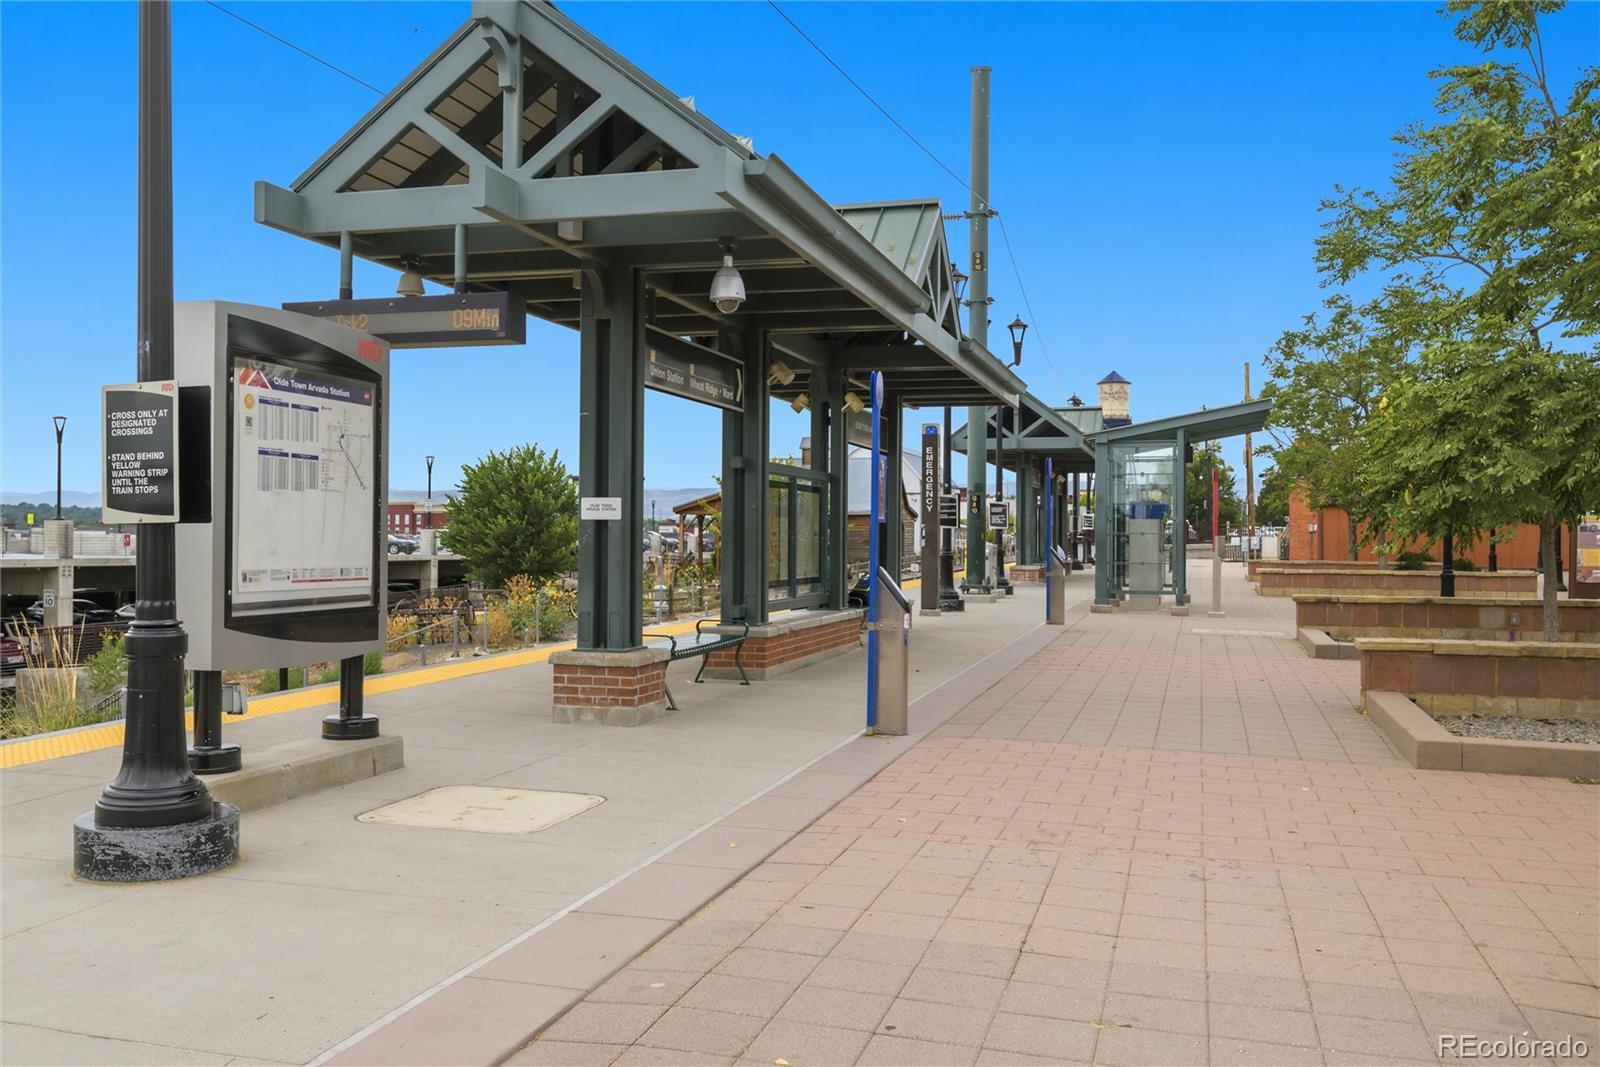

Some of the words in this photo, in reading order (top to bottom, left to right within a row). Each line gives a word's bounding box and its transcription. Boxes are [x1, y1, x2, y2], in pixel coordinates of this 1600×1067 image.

[453, 308, 500, 328] 09Min
[358, 339, 383, 362] RTD
[650, 364, 666, 380] Union
[666, 369, 684, 384] Station
[690, 377, 705, 392] Wheat
[705, 382, 719, 398] Ridge
[161, 384, 174, 392] RTD
[273, 376, 289, 388] Olde
[290, 380, 307, 390] Town
[308, 383, 329, 395] Arvada
[330, 387, 351, 398] Station
[111, 411, 136, 420] CROSS
[138, 410, 157, 418] ONLY
[158, 409, 168, 417] AT
[111, 418, 157, 428] DESIGNATED
[111, 427, 153, 436] CROSSINGS
[111, 453, 135, 461] STAND
[137, 451, 164, 460] BEHIND
[111, 461, 140, 469] YELLOW
[111, 469, 146, 478] WARNING
[147, 468, 168, 477] STRIP
[111, 478, 133, 486] UNTIL
[134, 477, 148, 485] THE
[111, 486, 133, 494] TRAIN
[135, 485, 159, 494] STOPS
